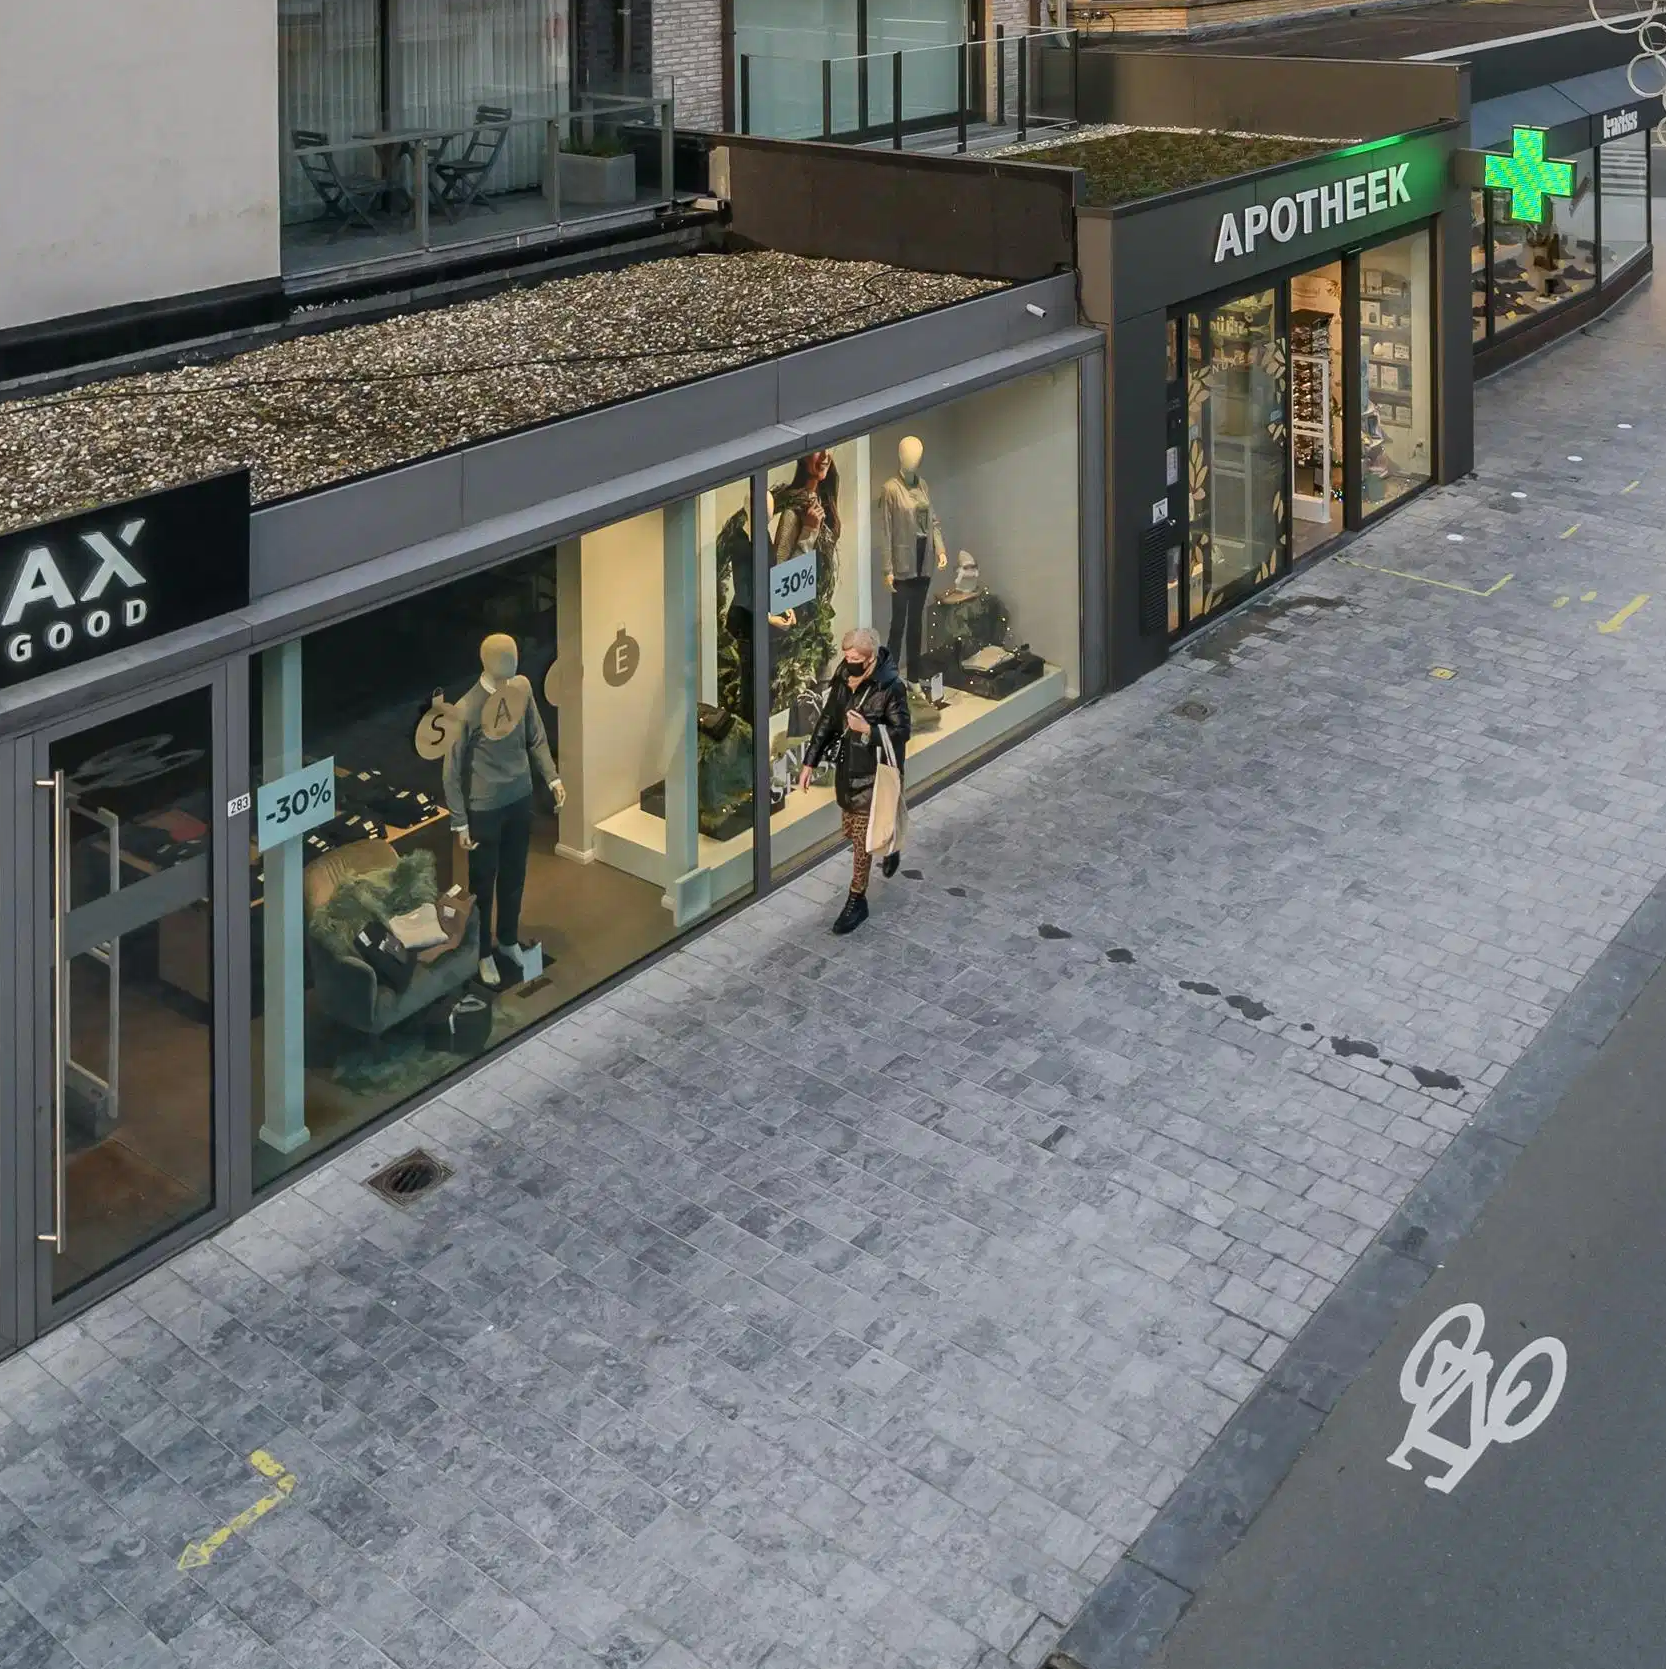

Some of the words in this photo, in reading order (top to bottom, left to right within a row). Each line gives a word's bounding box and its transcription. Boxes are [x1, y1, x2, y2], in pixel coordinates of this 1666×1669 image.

[1214, 162, 1412, 264] APOTHEEK
[774, 564, 815, 598] -30%
[7, 597, 148, 663] GOOD
[230, 796, 250, 815] 283
[265, 777, 332, 824] -30%
